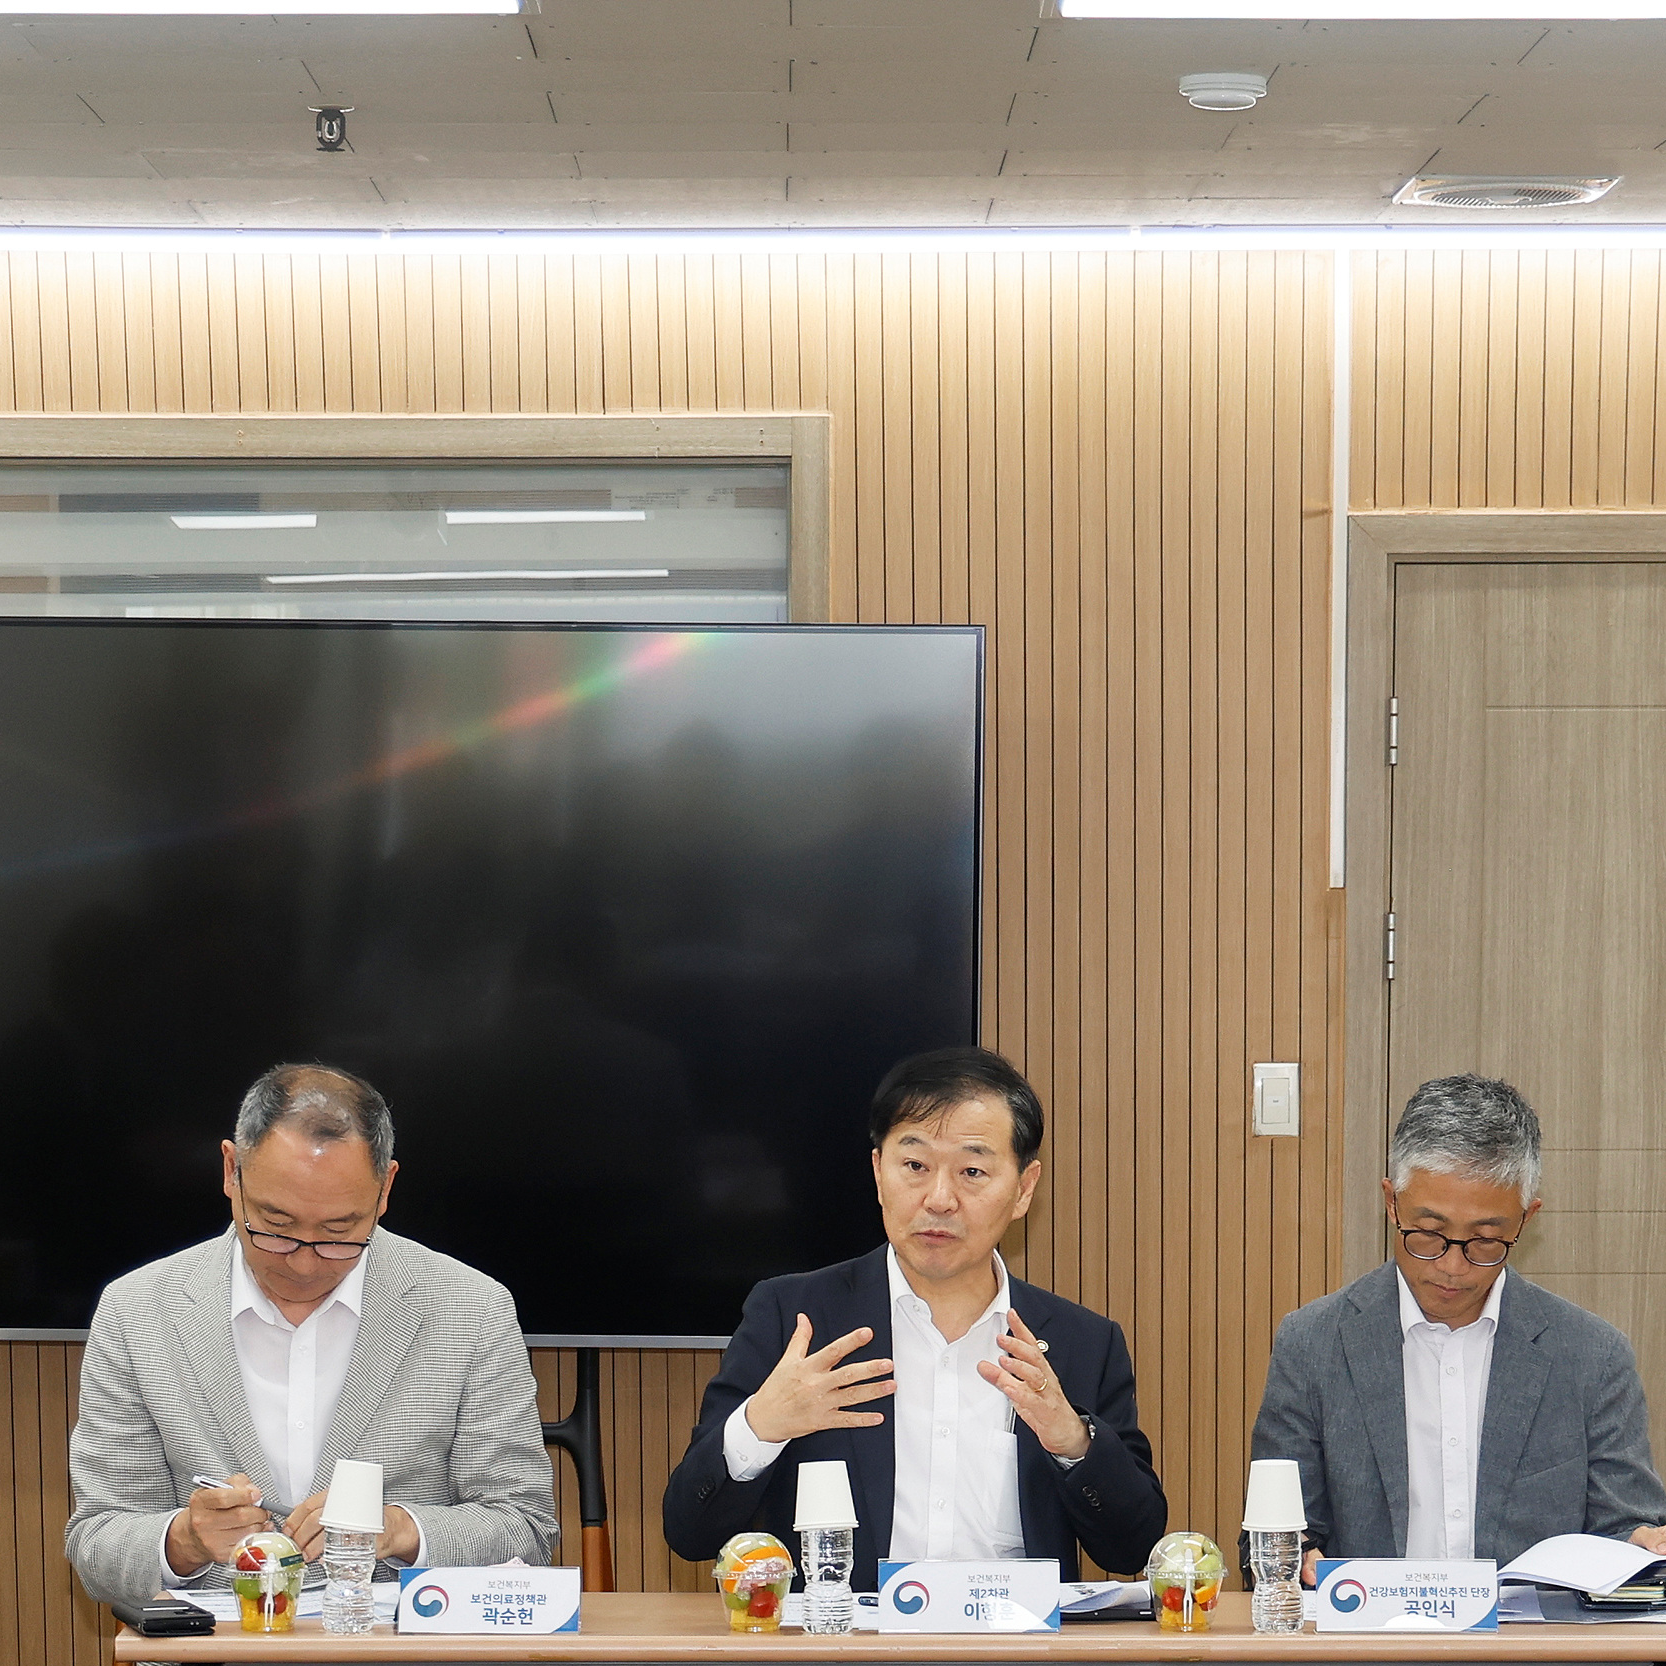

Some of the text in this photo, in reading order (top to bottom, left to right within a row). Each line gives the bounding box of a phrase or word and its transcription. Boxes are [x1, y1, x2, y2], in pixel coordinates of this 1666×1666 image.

[968, 1574, 1011, 1584] 보건복지부
[1405, 1573, 1449, 1582] 보건복지부
[488, 1580, 531, 1590] 보건복지부
[969, 1588, 1010, 1600] 제2차관
[1369, 1586, 1491, 1598] 건강보험지불혁신추진 단장
[470, 1593, 547, 1606] 보건의료정책관
[1404, 1600, 1455, 1618] 공인식
[483, 1607, 533, 1625] 곽순헌
